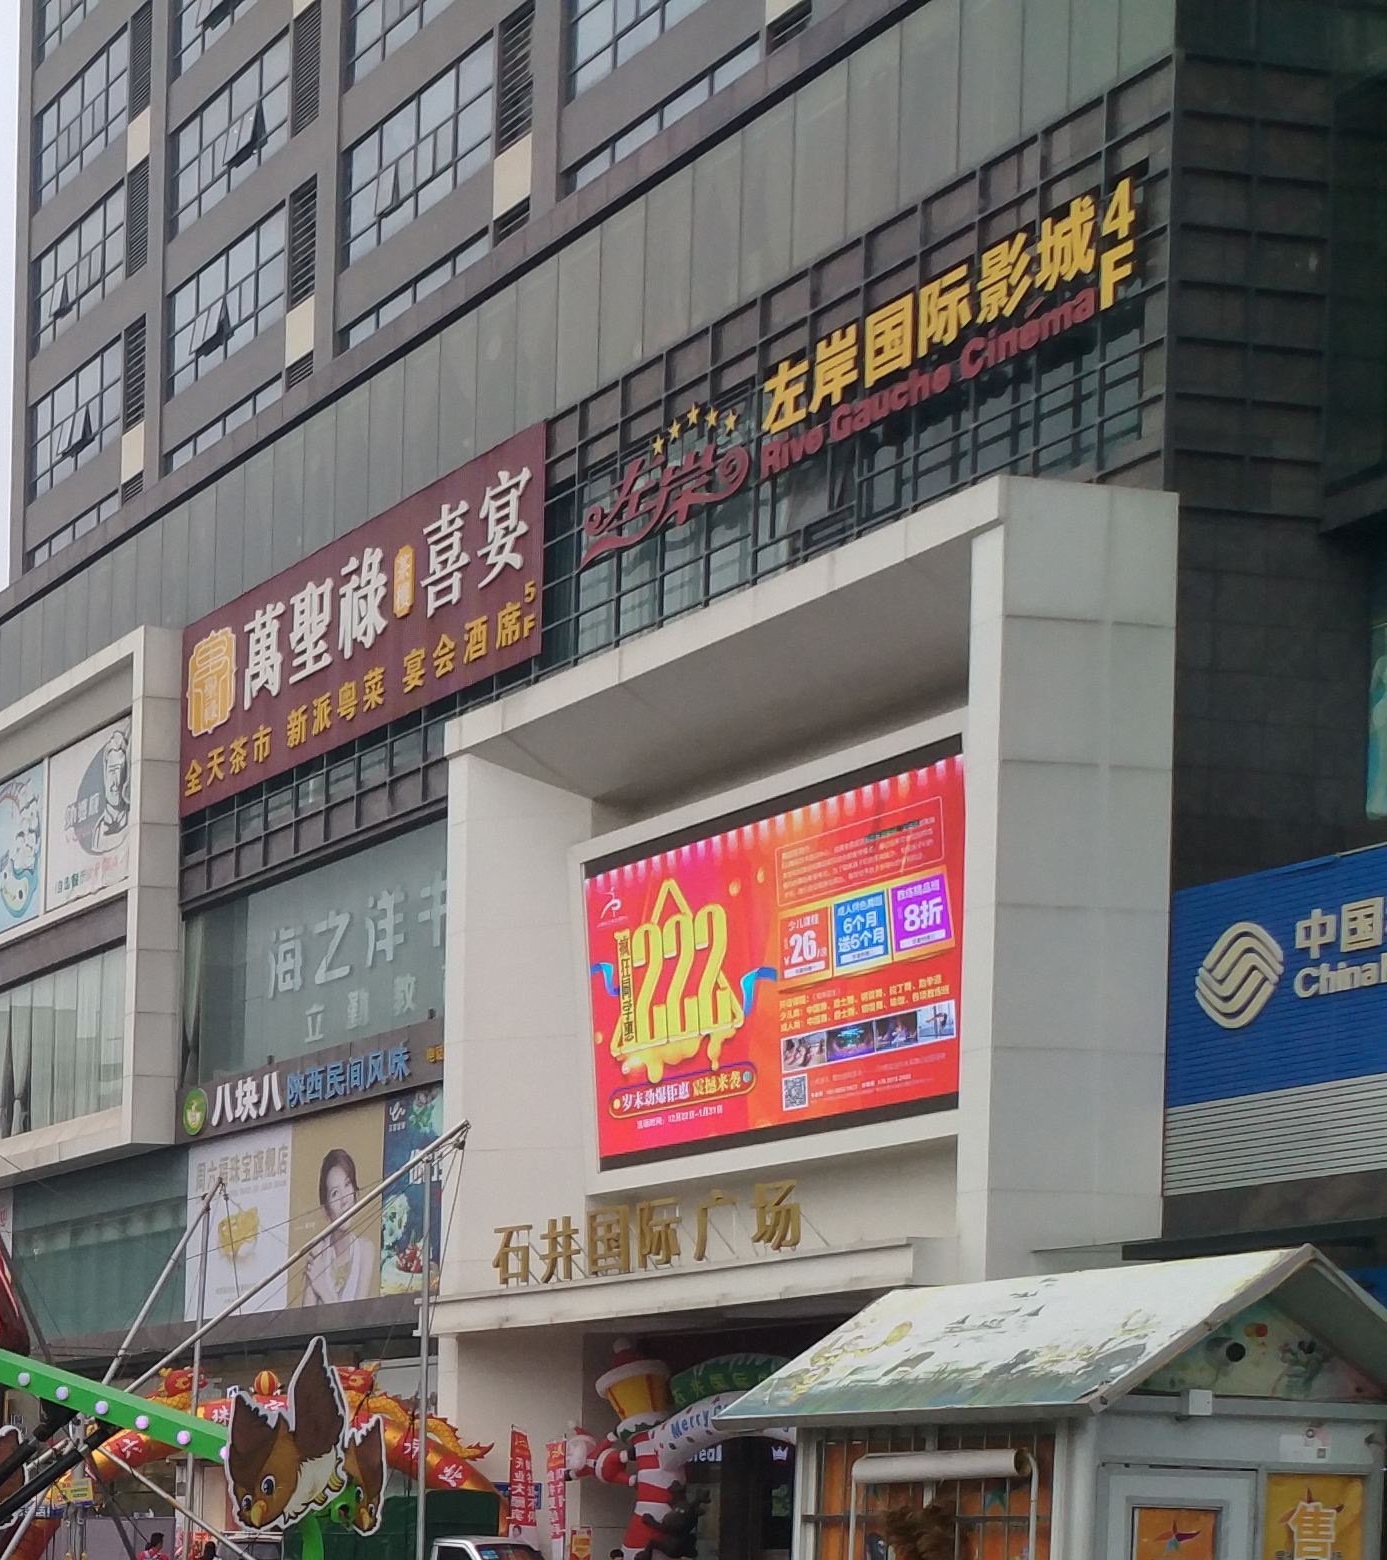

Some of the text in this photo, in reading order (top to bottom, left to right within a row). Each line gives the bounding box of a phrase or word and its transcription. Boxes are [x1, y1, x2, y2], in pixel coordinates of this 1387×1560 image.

[762, 194, 1096, 434] 左岸国际影城
[760, 420, 822, 479] Rive
[829, 365, 951, 440] Gauche
[420, 466, 532, 619] 喜宴
[184, 725, 272, 798] 全天茶市
[286, 667, 386, 748] 新派粤菜
[402, 602, 521, 694] 宴会酒席
[843, 911, 877, 934] 6个月
[904, 897, 943, 932] 8折
[1294, 896, 1387, 959] 中国
[211, 1044, 411, 1127] 八块八 陕西民间风味
[492, 1179, 803, 1285] 石井国际广场
[671, 1410, 710, 1439] Merry
